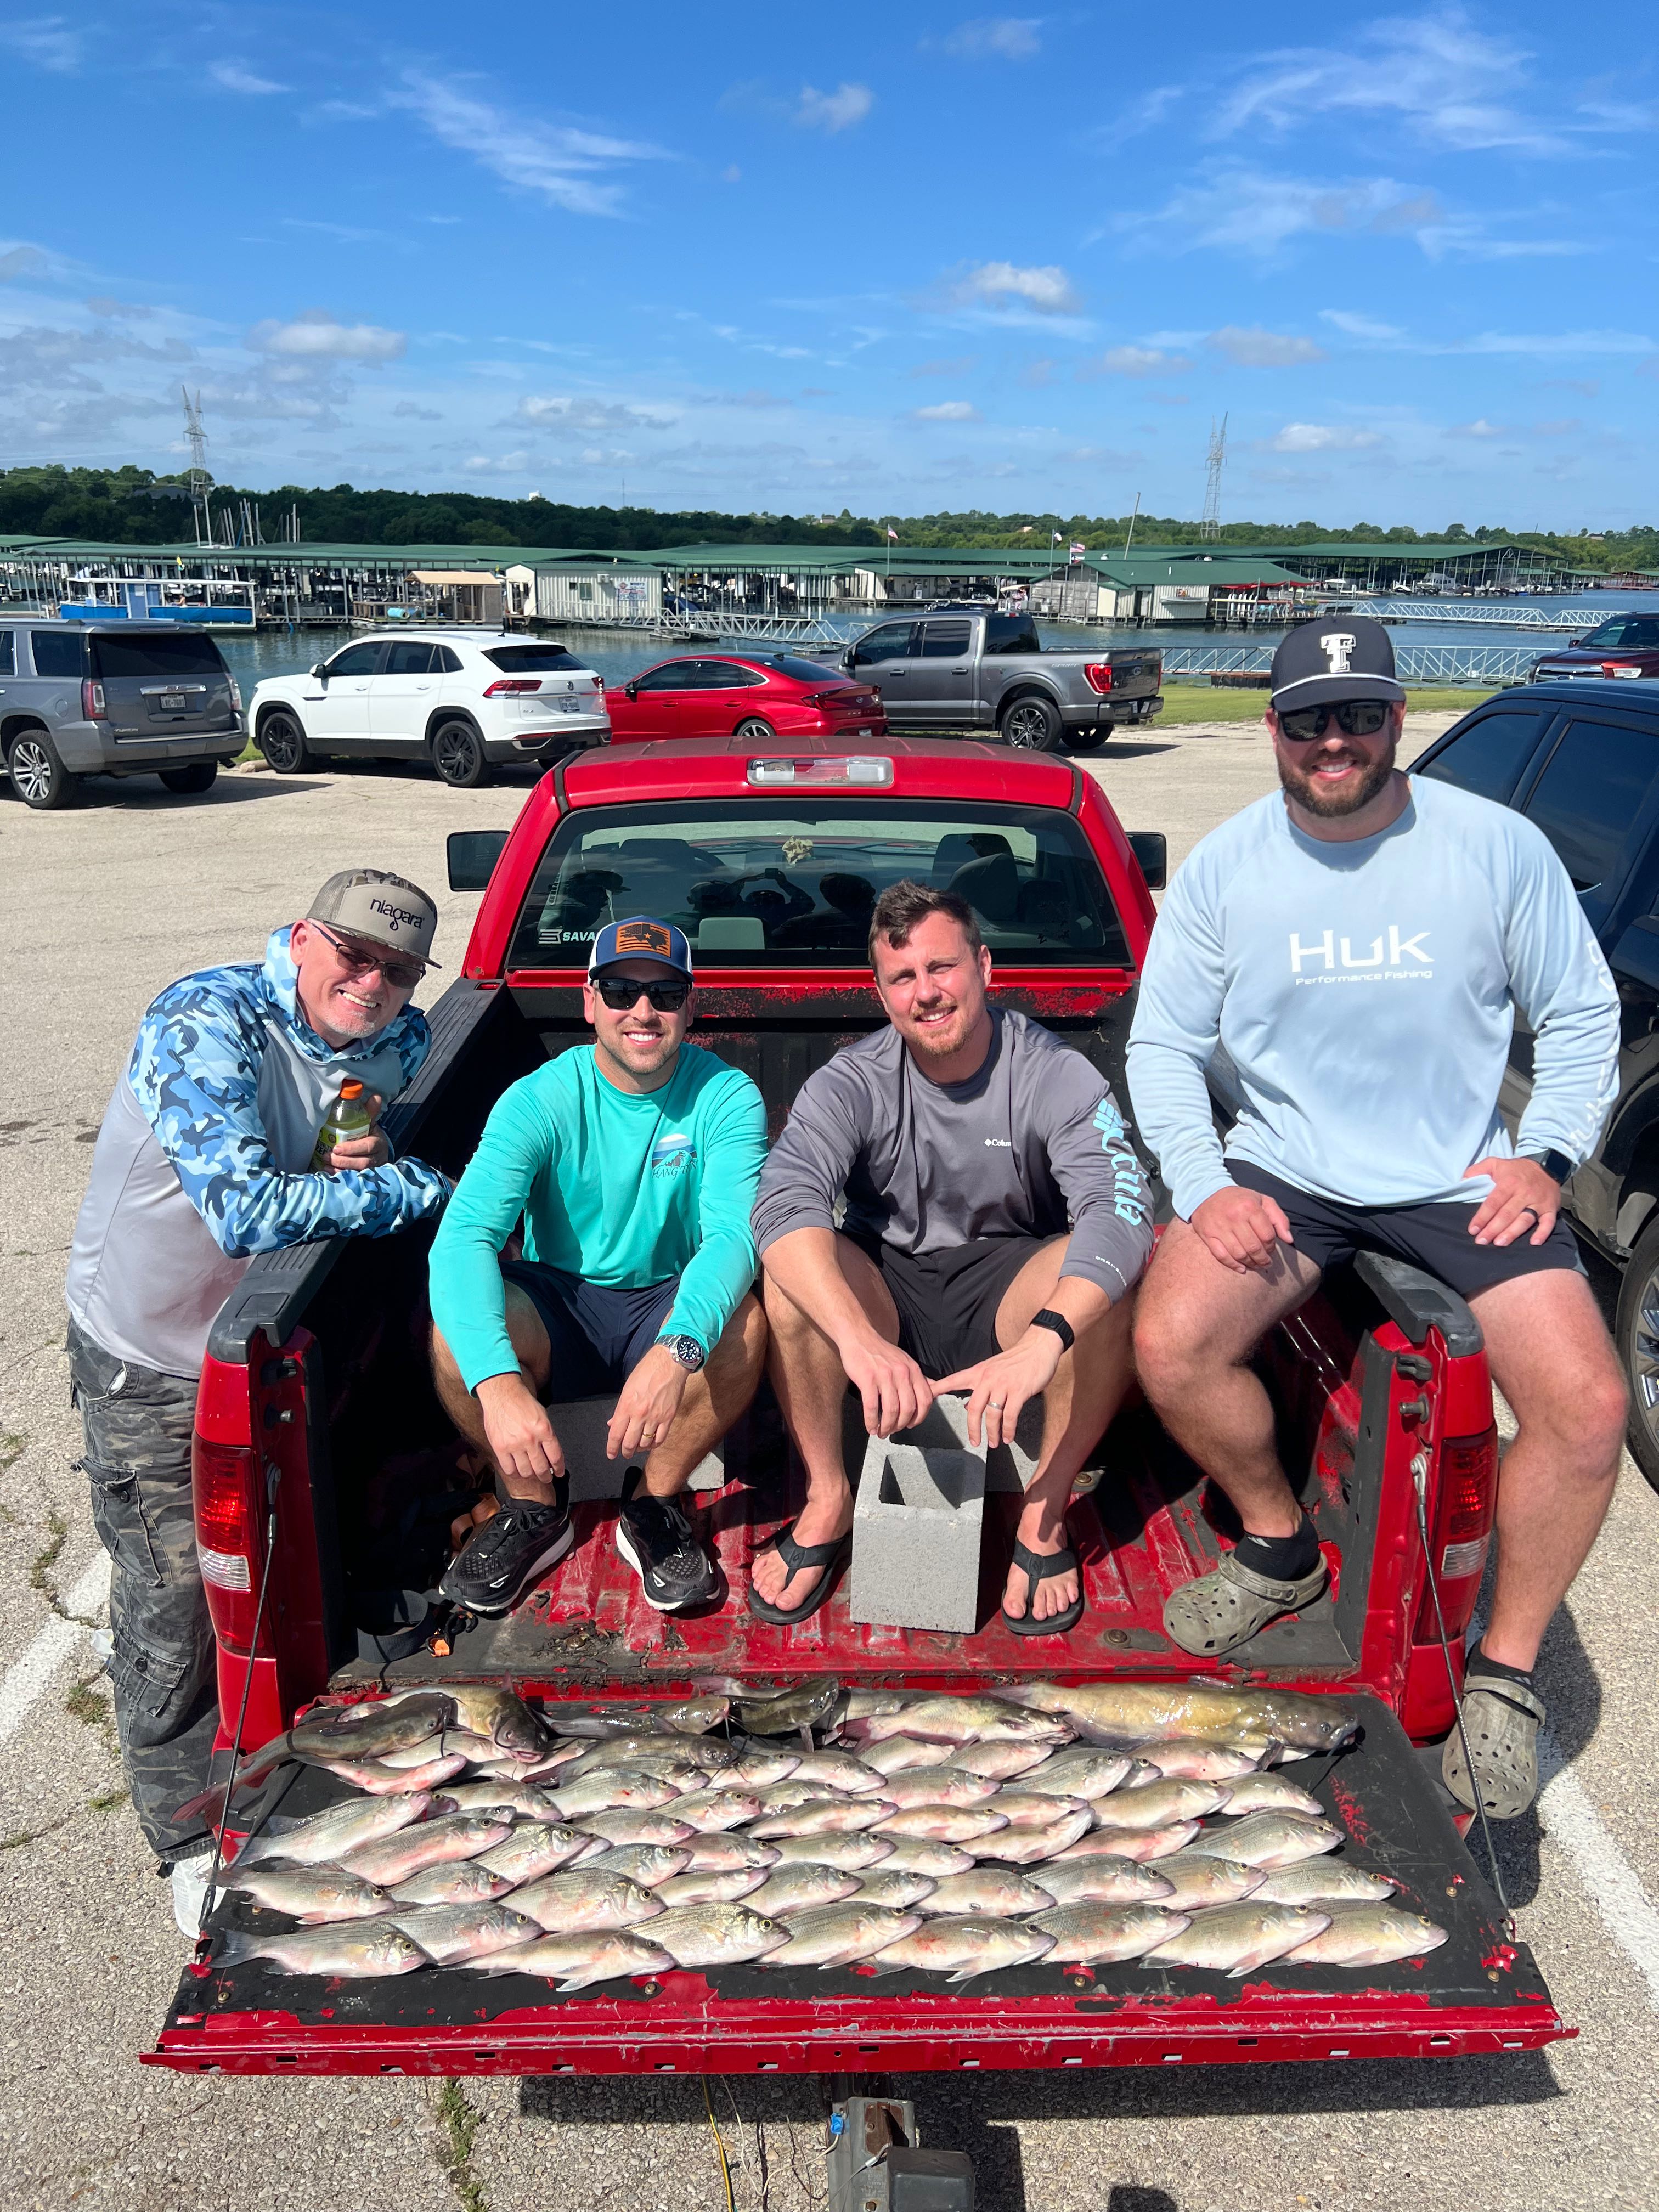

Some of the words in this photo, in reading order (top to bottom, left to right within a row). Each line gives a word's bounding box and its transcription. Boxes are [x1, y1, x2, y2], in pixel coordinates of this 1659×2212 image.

[369, 899, 422, 931] niagara
[563, 932, 596, 941] SAVA
[1289, 924, 1435, 973] Huk
[1295, 973, 1383, 986] Performance
[1384, 970, 1433, 980] Fishing
[652, 1166, 679, 1181] HANG
[680, 1159, 699, 1175] TEN
